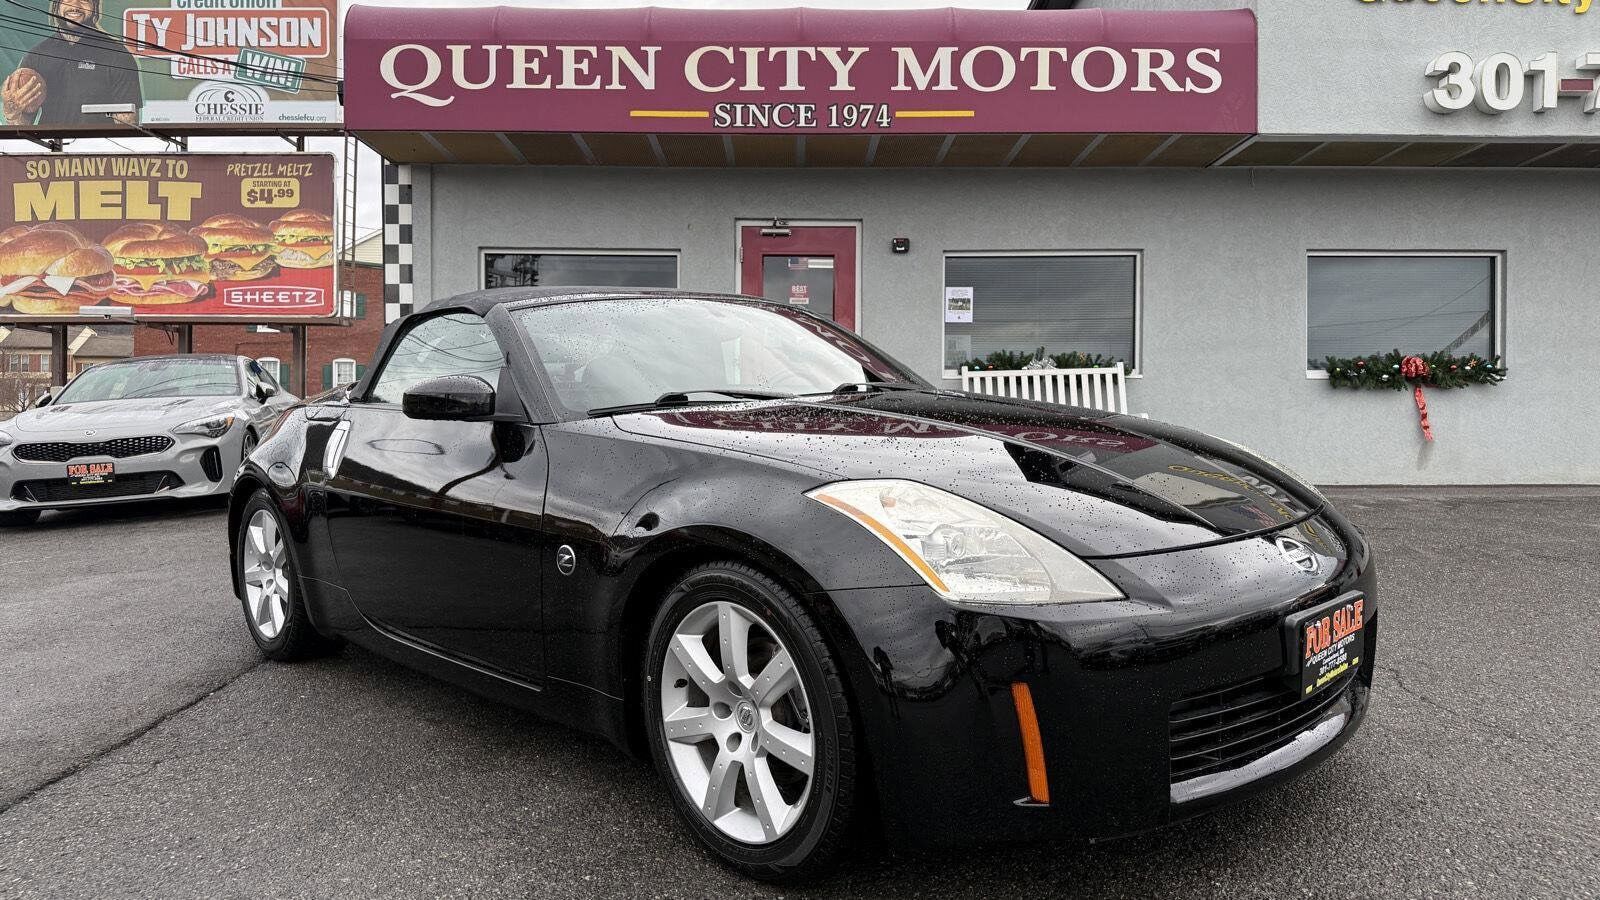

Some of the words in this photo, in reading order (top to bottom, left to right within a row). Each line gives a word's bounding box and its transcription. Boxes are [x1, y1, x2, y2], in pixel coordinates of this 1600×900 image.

[132, 13, 172, 51] TY
[180, 13, 322, 51] JOHNSON
[177, 57, 218, 76] CALLS
[221, 60, 232, 75] A
[246, 52, 297, 87] WIN!
[380, 44, 662, 107] QUEEN
[684, 45, 869, 93] CITY
[891, 45, 1223, 94] MOTORS
[195, 103, 265, 115] CHESSIE
[278, 113, 327, 122] chessiefcu.org
[713, 102, 818, 128] SINCE
[827, 103, 892, 128] 1974
[26, 160, 51, 180] SO
[54, 158, 107, 178] MANY
[111, 158, 162, 178] WAYZ
[166, 159, 189, 179] TO
[226, 163, 274, 177] PRETZEL
[277, 162, 313, 177] MELTZ
[252, 180, 282, 188] STARTING
[283, 180, 291, 188] AT
[13, 180, 202, 222] MELT
[246, 188, 294, 204] $4.99
[231, 291, 317, 303] SHEETZ
[68, 464, 88, 476] FOR
[90, 462, 113, 473] SALE
[1304, 616, 1331, 660] FOR
[1333, 599, 1364, 643] SALE
